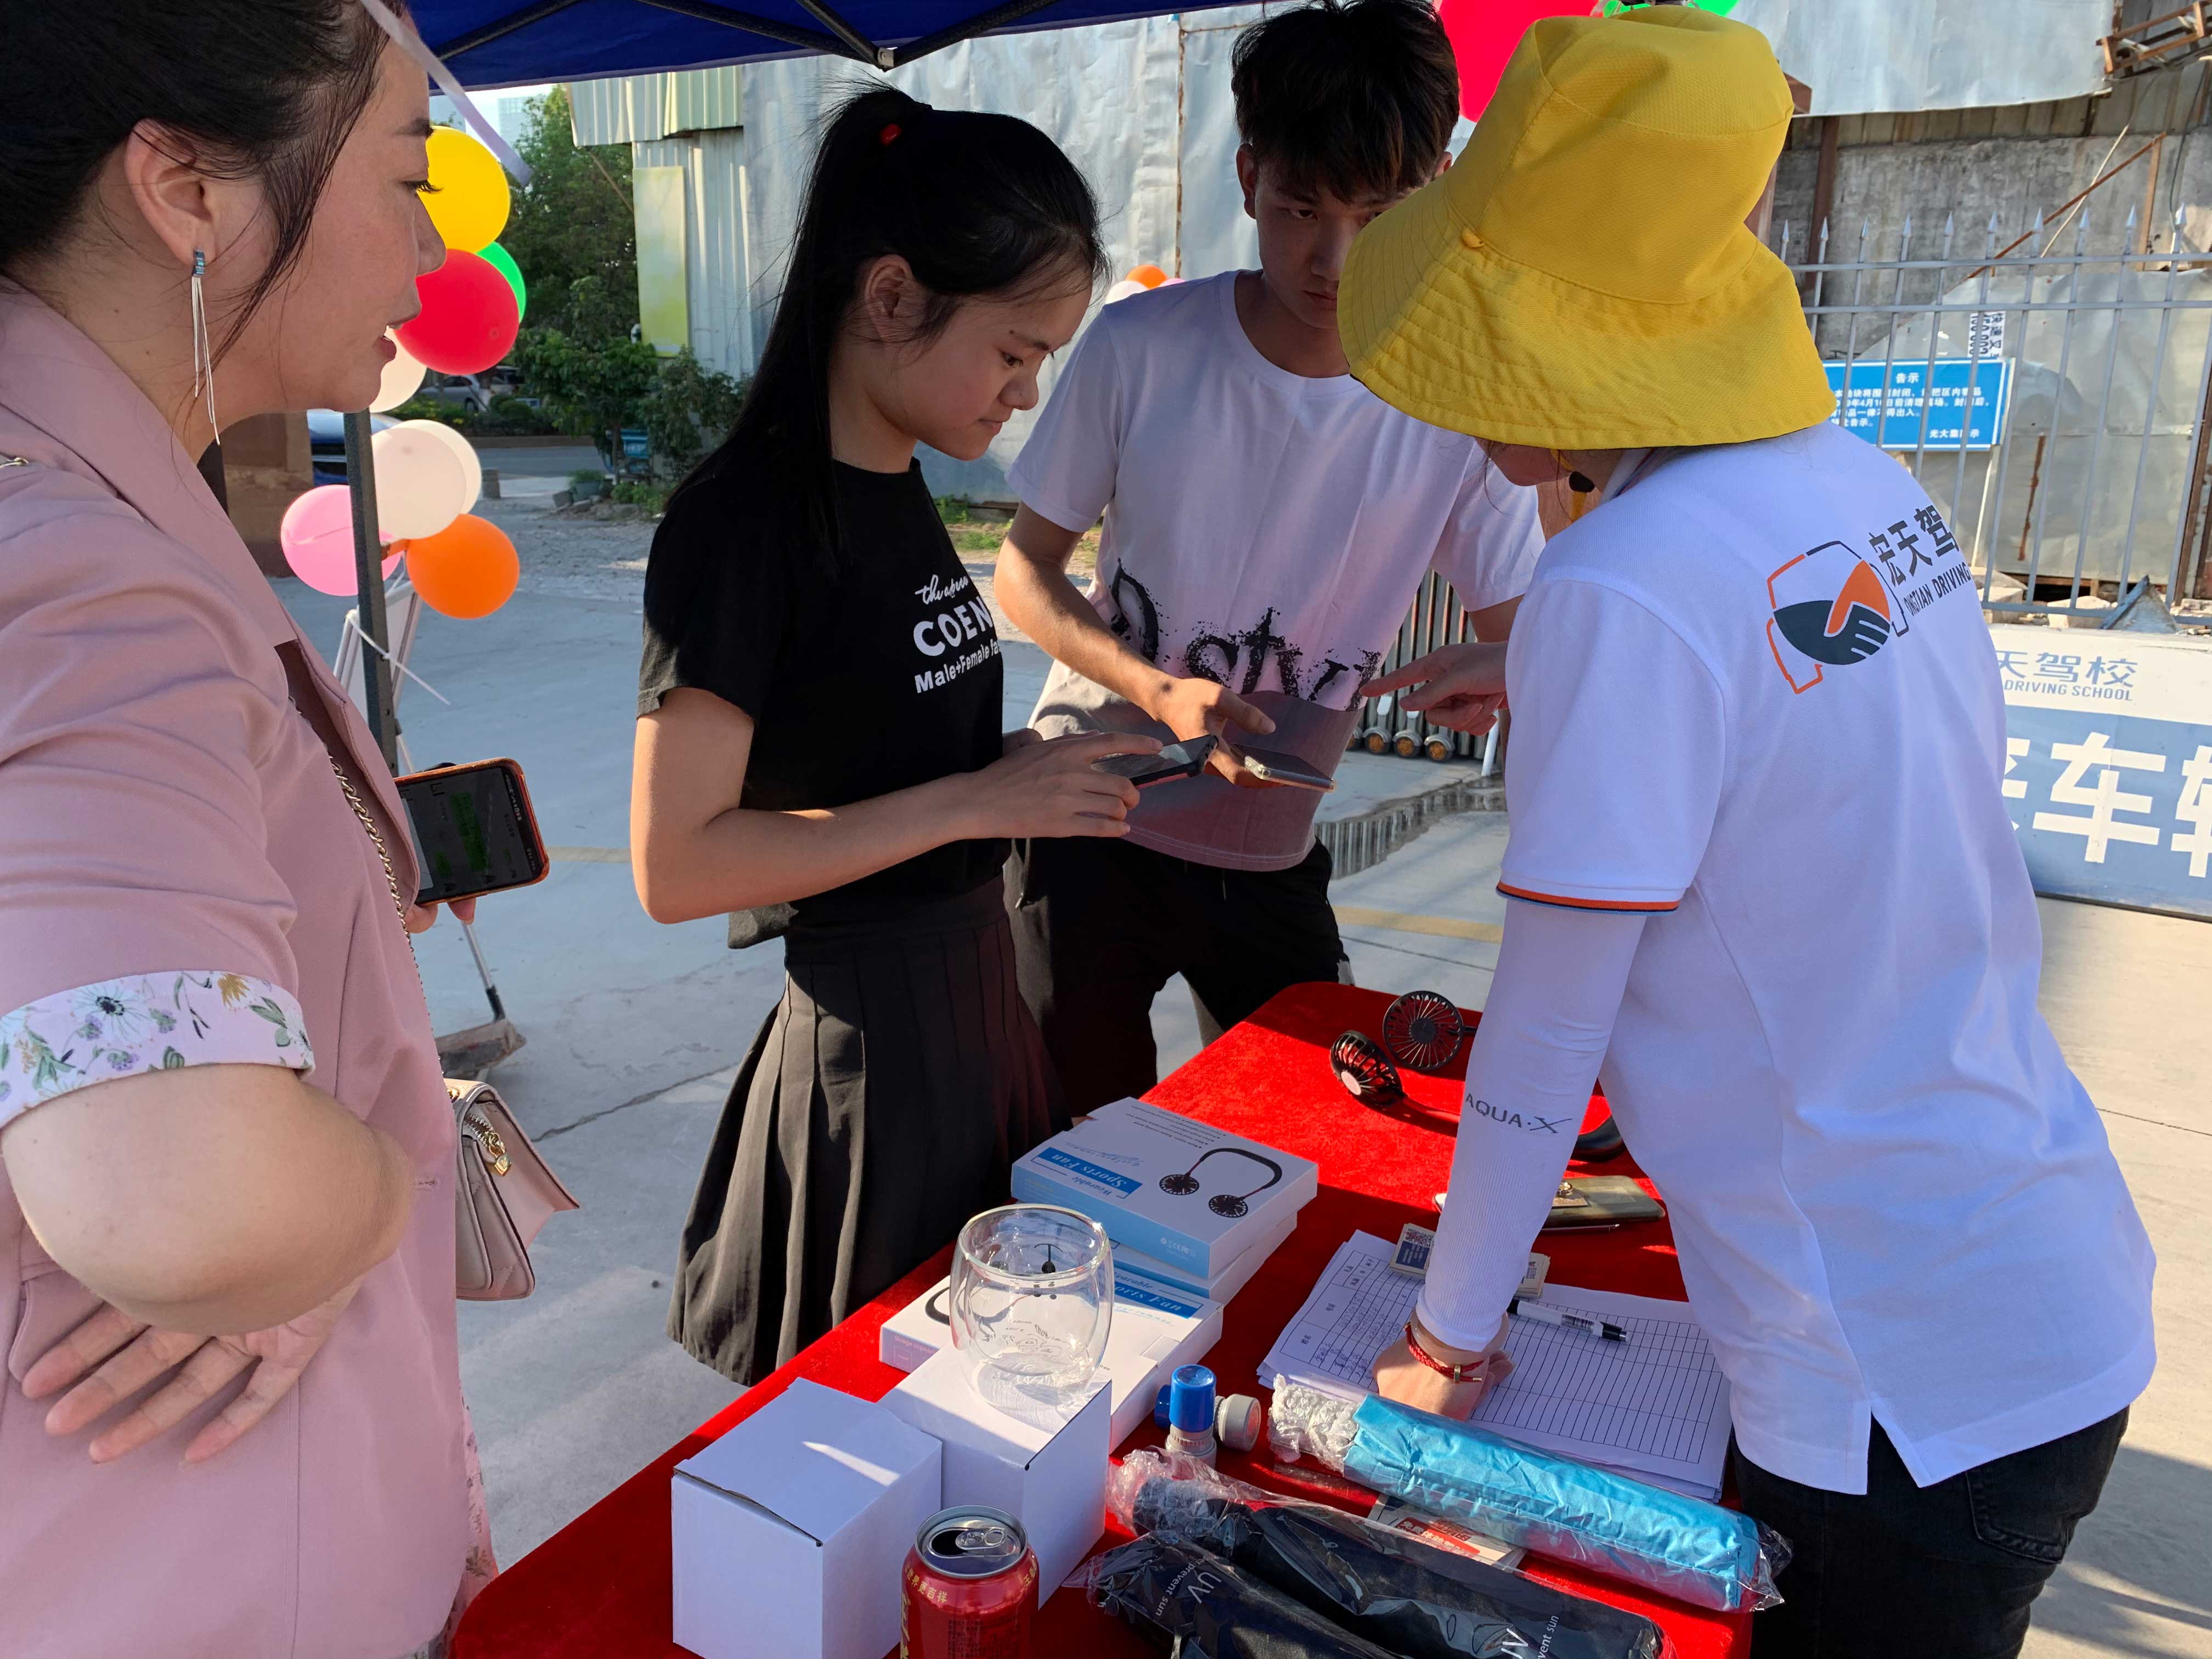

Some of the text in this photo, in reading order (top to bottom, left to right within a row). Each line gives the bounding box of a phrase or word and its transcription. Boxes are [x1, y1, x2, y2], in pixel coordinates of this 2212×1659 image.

[1895, 373, 1919, 384] 告示
[1903, 562, 1972, 617] ONGTIAN DRIVING
[913, 596, 993, 656] COEN
[1995, 650, 2137, 687] 天驾校
[2004, 680, 2134, 701] DRIVING SCHOOL
[1051, 1154, 1127, 1188] Sports Fan
[1071, 1176, 1113, 1196] Wearable
[1114, 1271, 1153, 1289] earable
[1115, 1285, 1182, 1311] orts Fan
[1300, 1334, 1311, 1345] 姓名
[1165, 1562, 1195, 1596] prevent
[1187, 1572, 1222, 1604] UV
[1155, 1596, 1169, 1617] sun
[1537, 1615, 1560, 1659] vent sun
